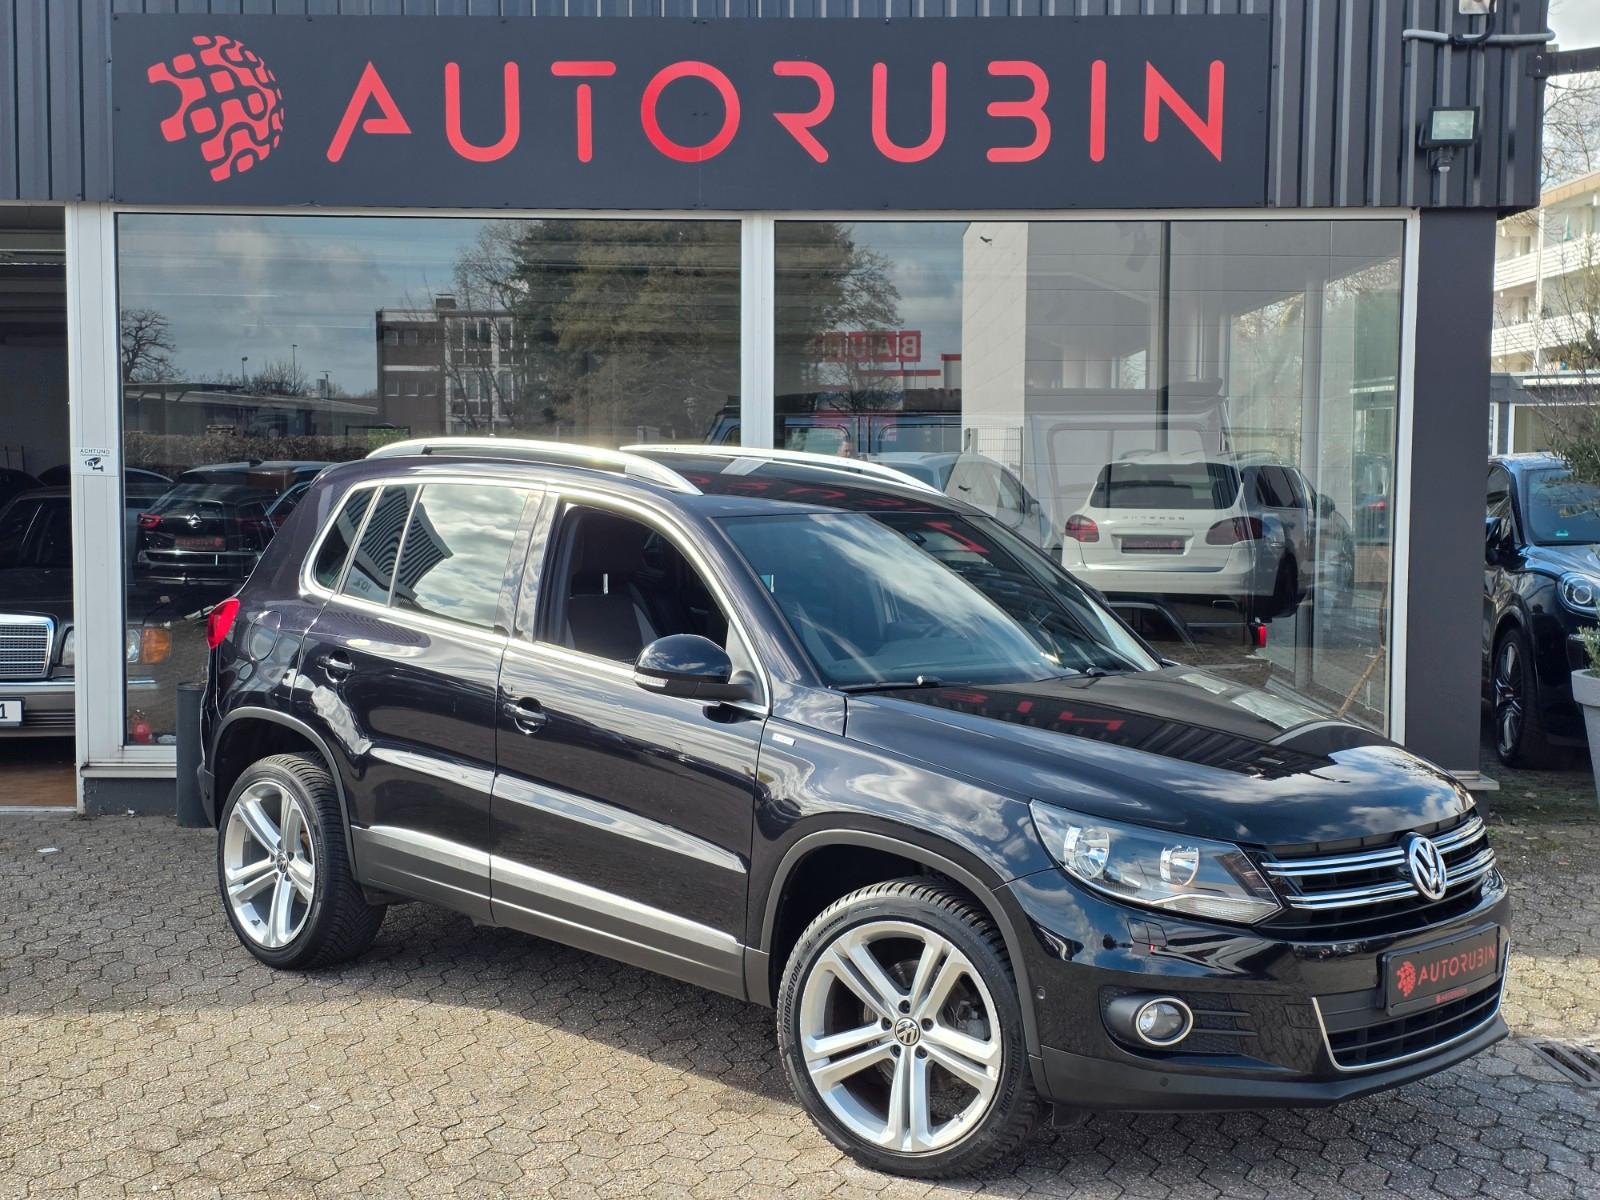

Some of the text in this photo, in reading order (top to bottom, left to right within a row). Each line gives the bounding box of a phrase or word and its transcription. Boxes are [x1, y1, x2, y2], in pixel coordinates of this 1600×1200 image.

[327, 60, 1225, 163] AUTORUBIN
[782, 959, 804, 1035] BRIDGESTONE
[1418, 944, 1496, 986] AUTORUBIN
